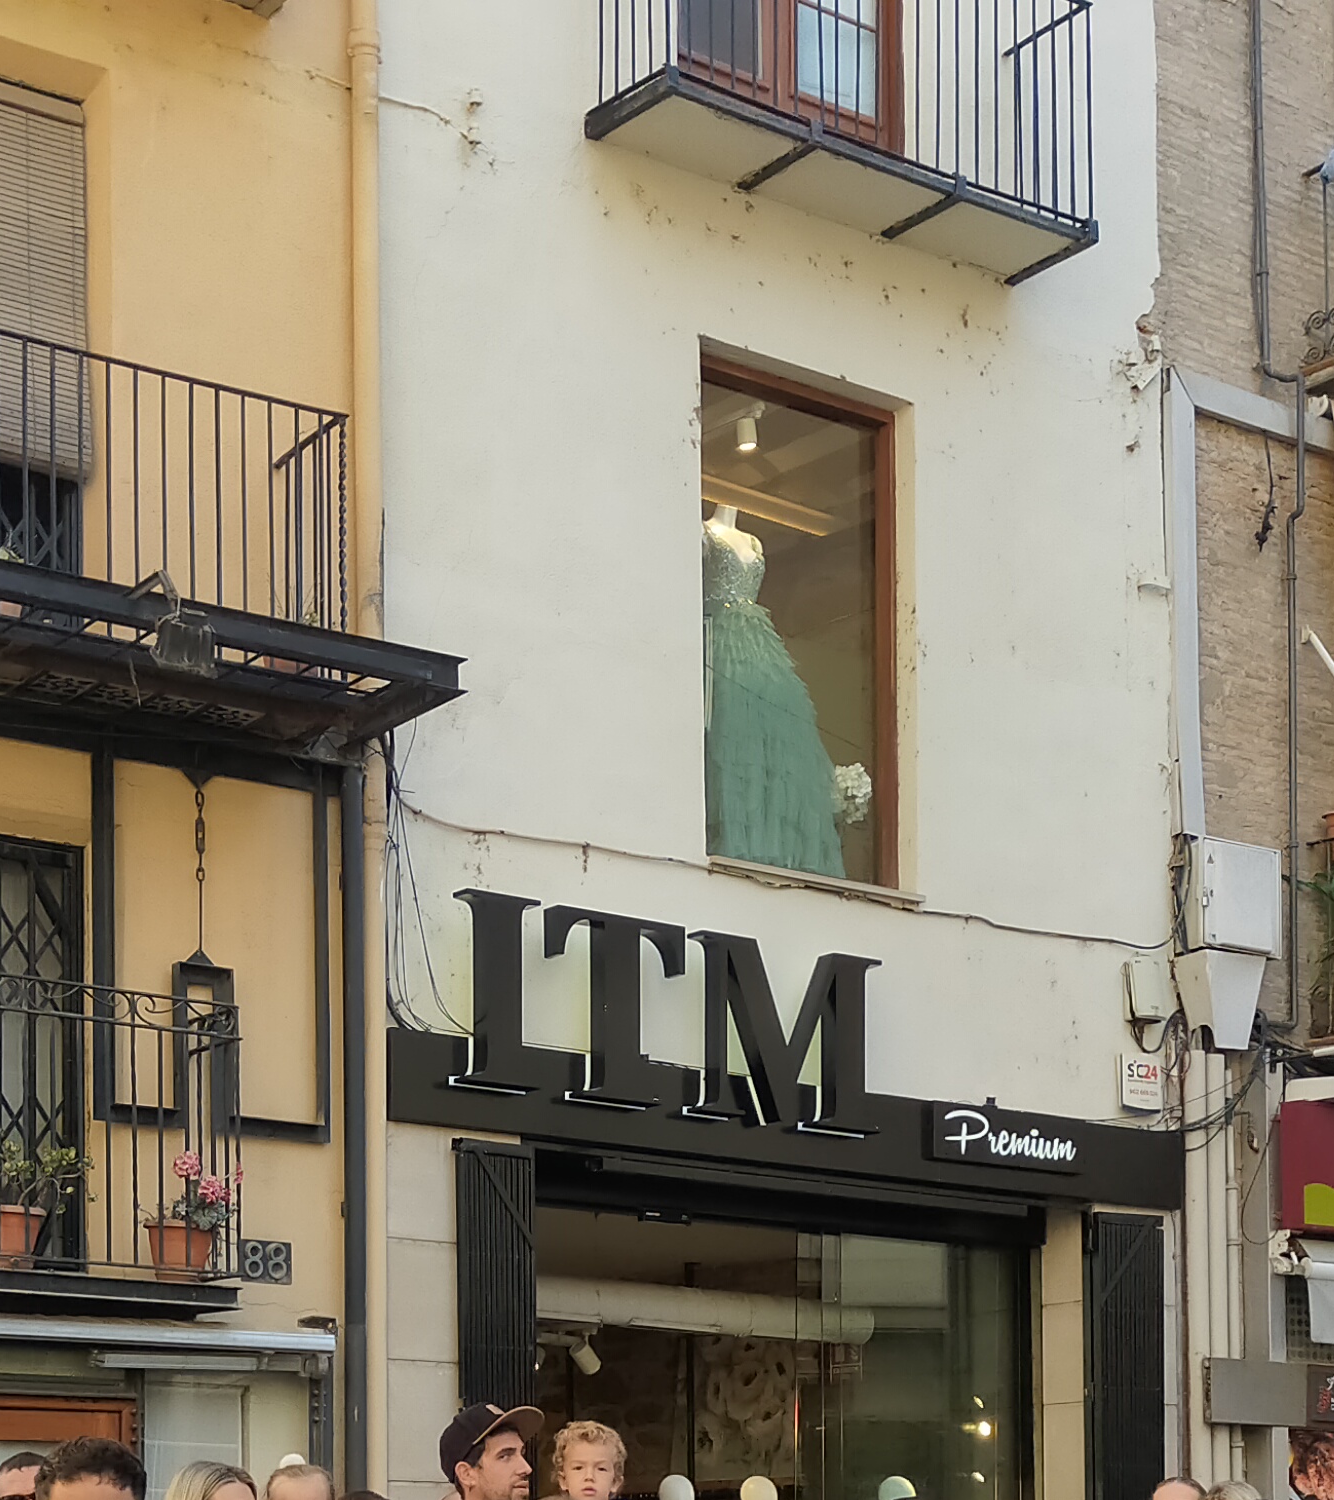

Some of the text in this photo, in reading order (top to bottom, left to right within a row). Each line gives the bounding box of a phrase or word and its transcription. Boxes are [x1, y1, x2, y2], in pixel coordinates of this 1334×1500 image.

[449, 888, 882, 1138] ITM
[944, 1109, 1077, 1162] Premium
[245, 1241, 287, 1279] 88
